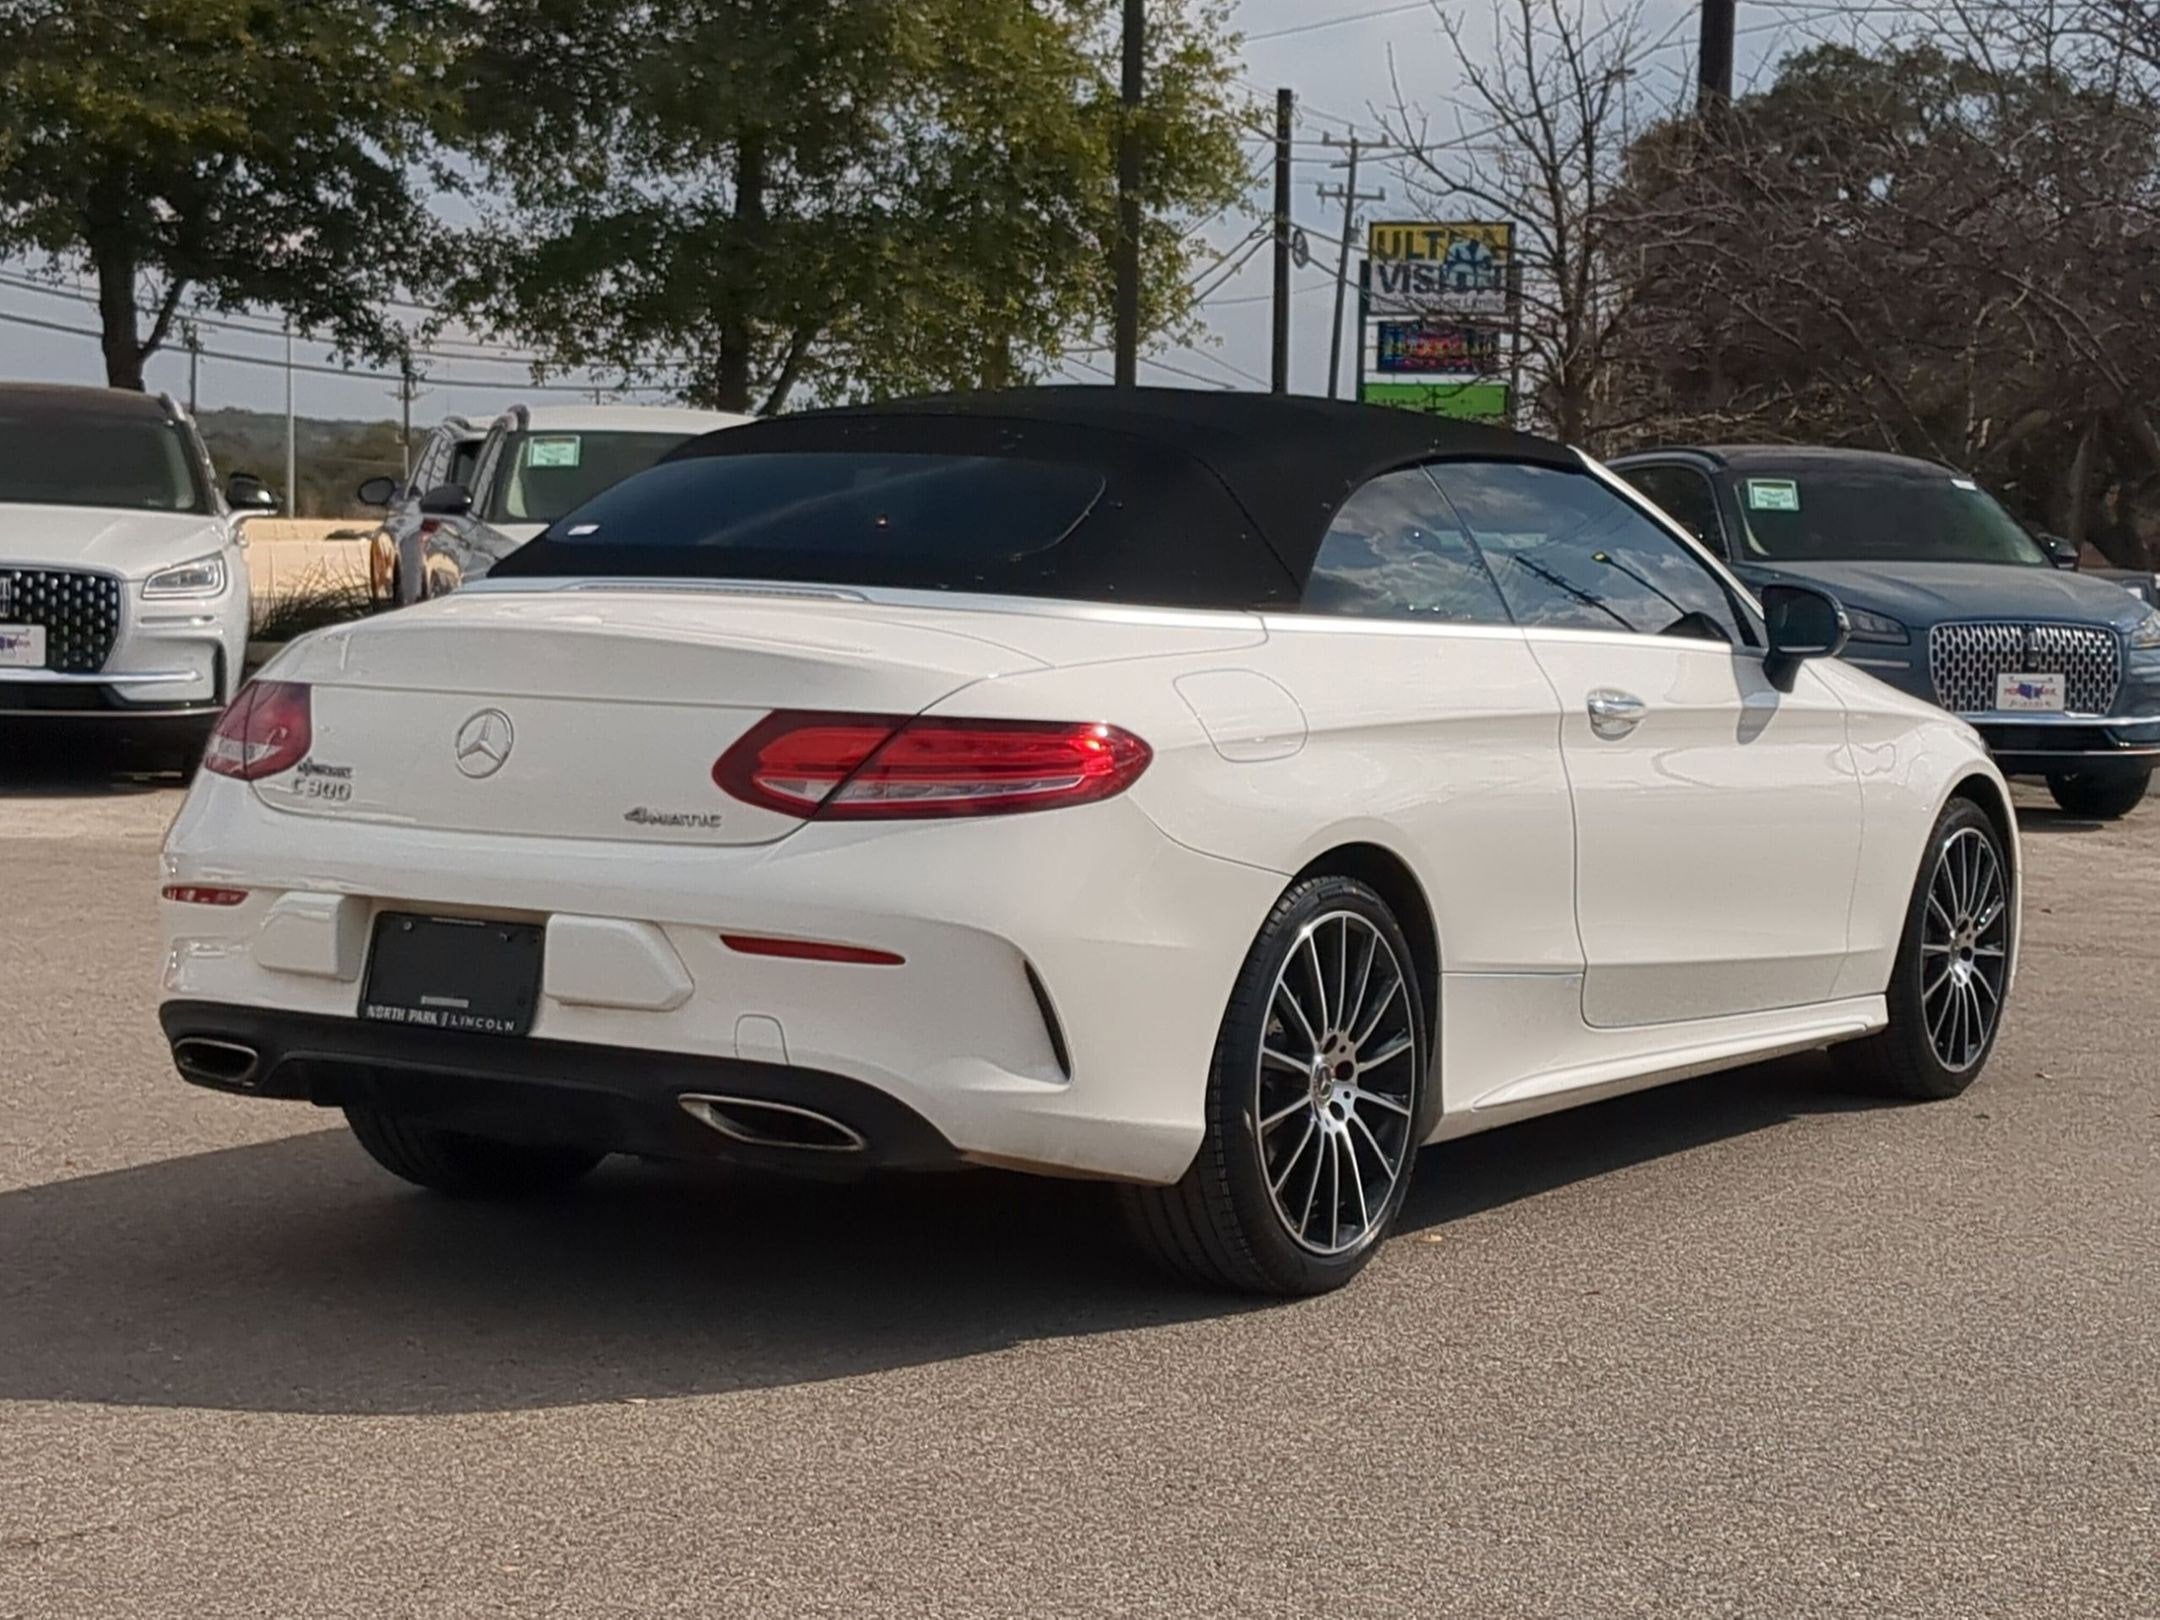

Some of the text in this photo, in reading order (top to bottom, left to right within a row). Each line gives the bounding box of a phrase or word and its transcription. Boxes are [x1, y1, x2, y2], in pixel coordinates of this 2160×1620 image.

[1376, 230, 1506, 260] ULT
[1377, 263, 1502, 293] VISI
[366, 1004, 515, 1031] NORTH PARK LINCOLN
